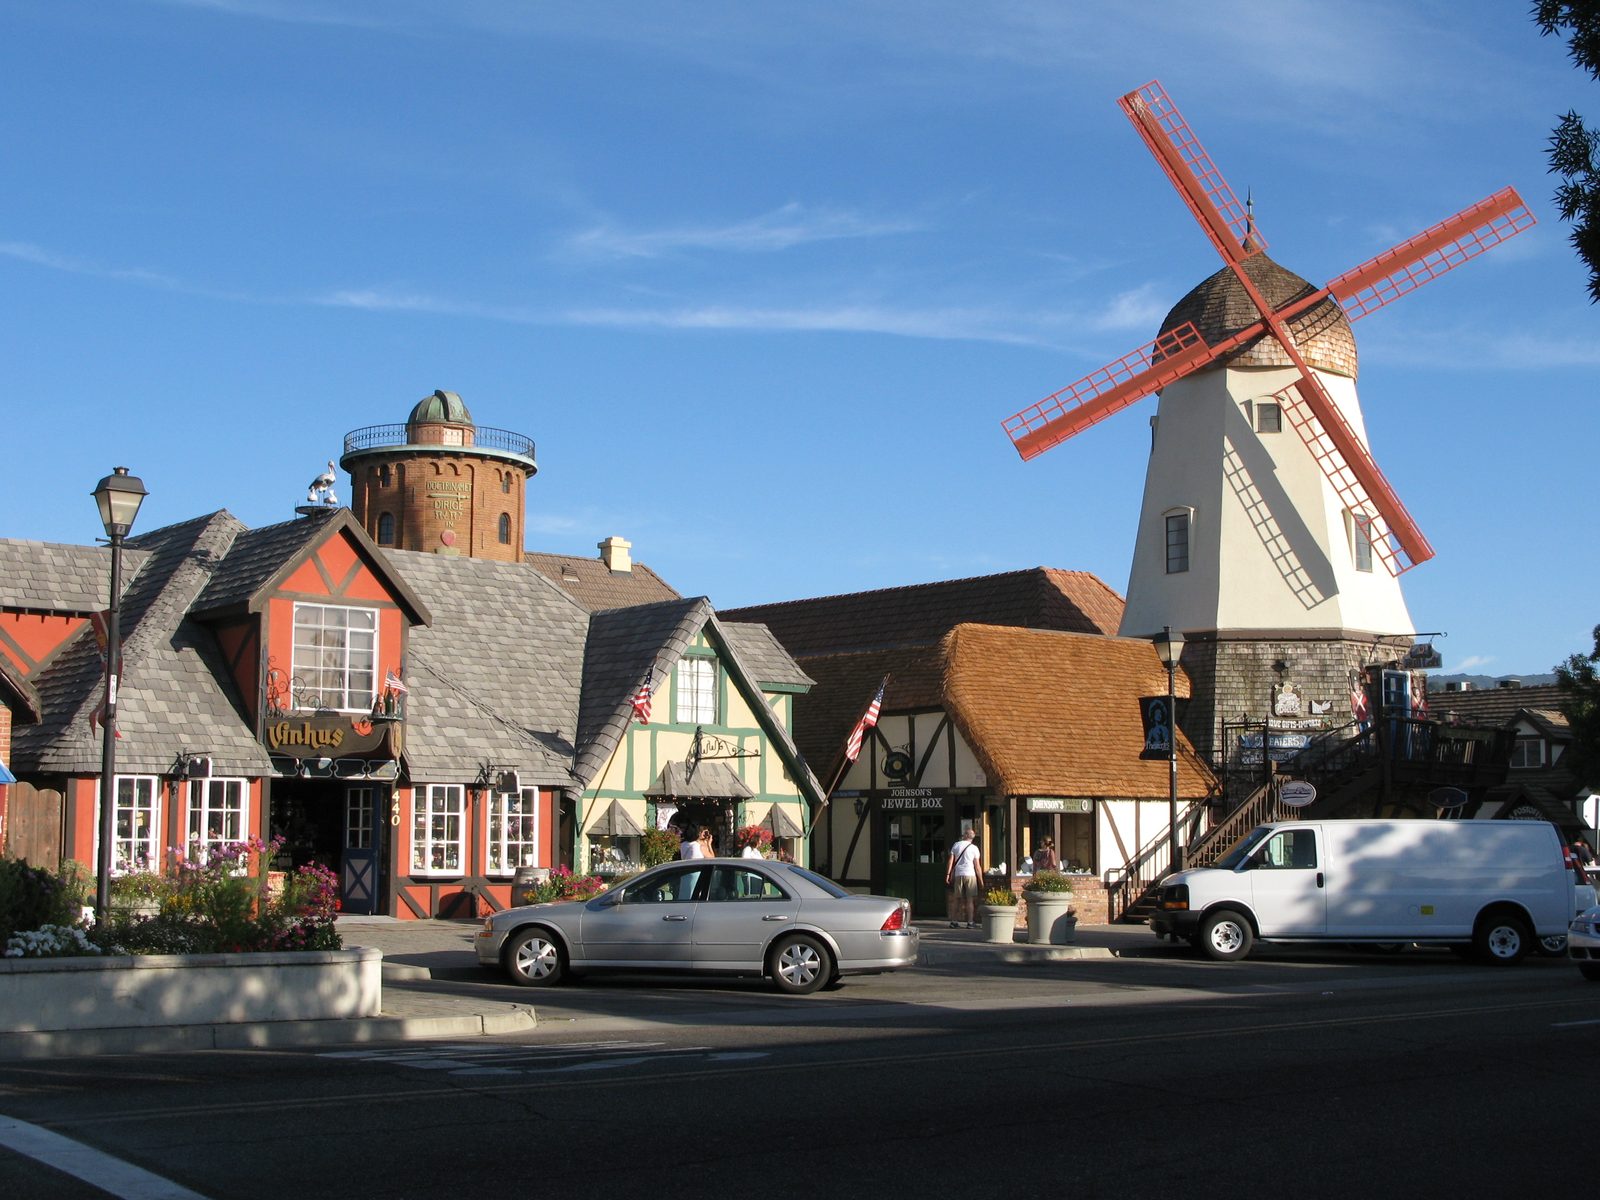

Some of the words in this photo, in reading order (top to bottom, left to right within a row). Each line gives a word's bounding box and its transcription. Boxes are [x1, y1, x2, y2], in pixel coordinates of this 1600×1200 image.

[434, 500, 463, 511] DIRIGE
[269, 721, 345, 749] Vinhus
[891, 788, 932, 797] JOHNSON'S
[391, 790, 401, 826] 440
[881, 798, 919, 809] JEWEL
[921, 797, 943, 808] BOX
[1032, 799, 1064, 811] JOHNSON'S
